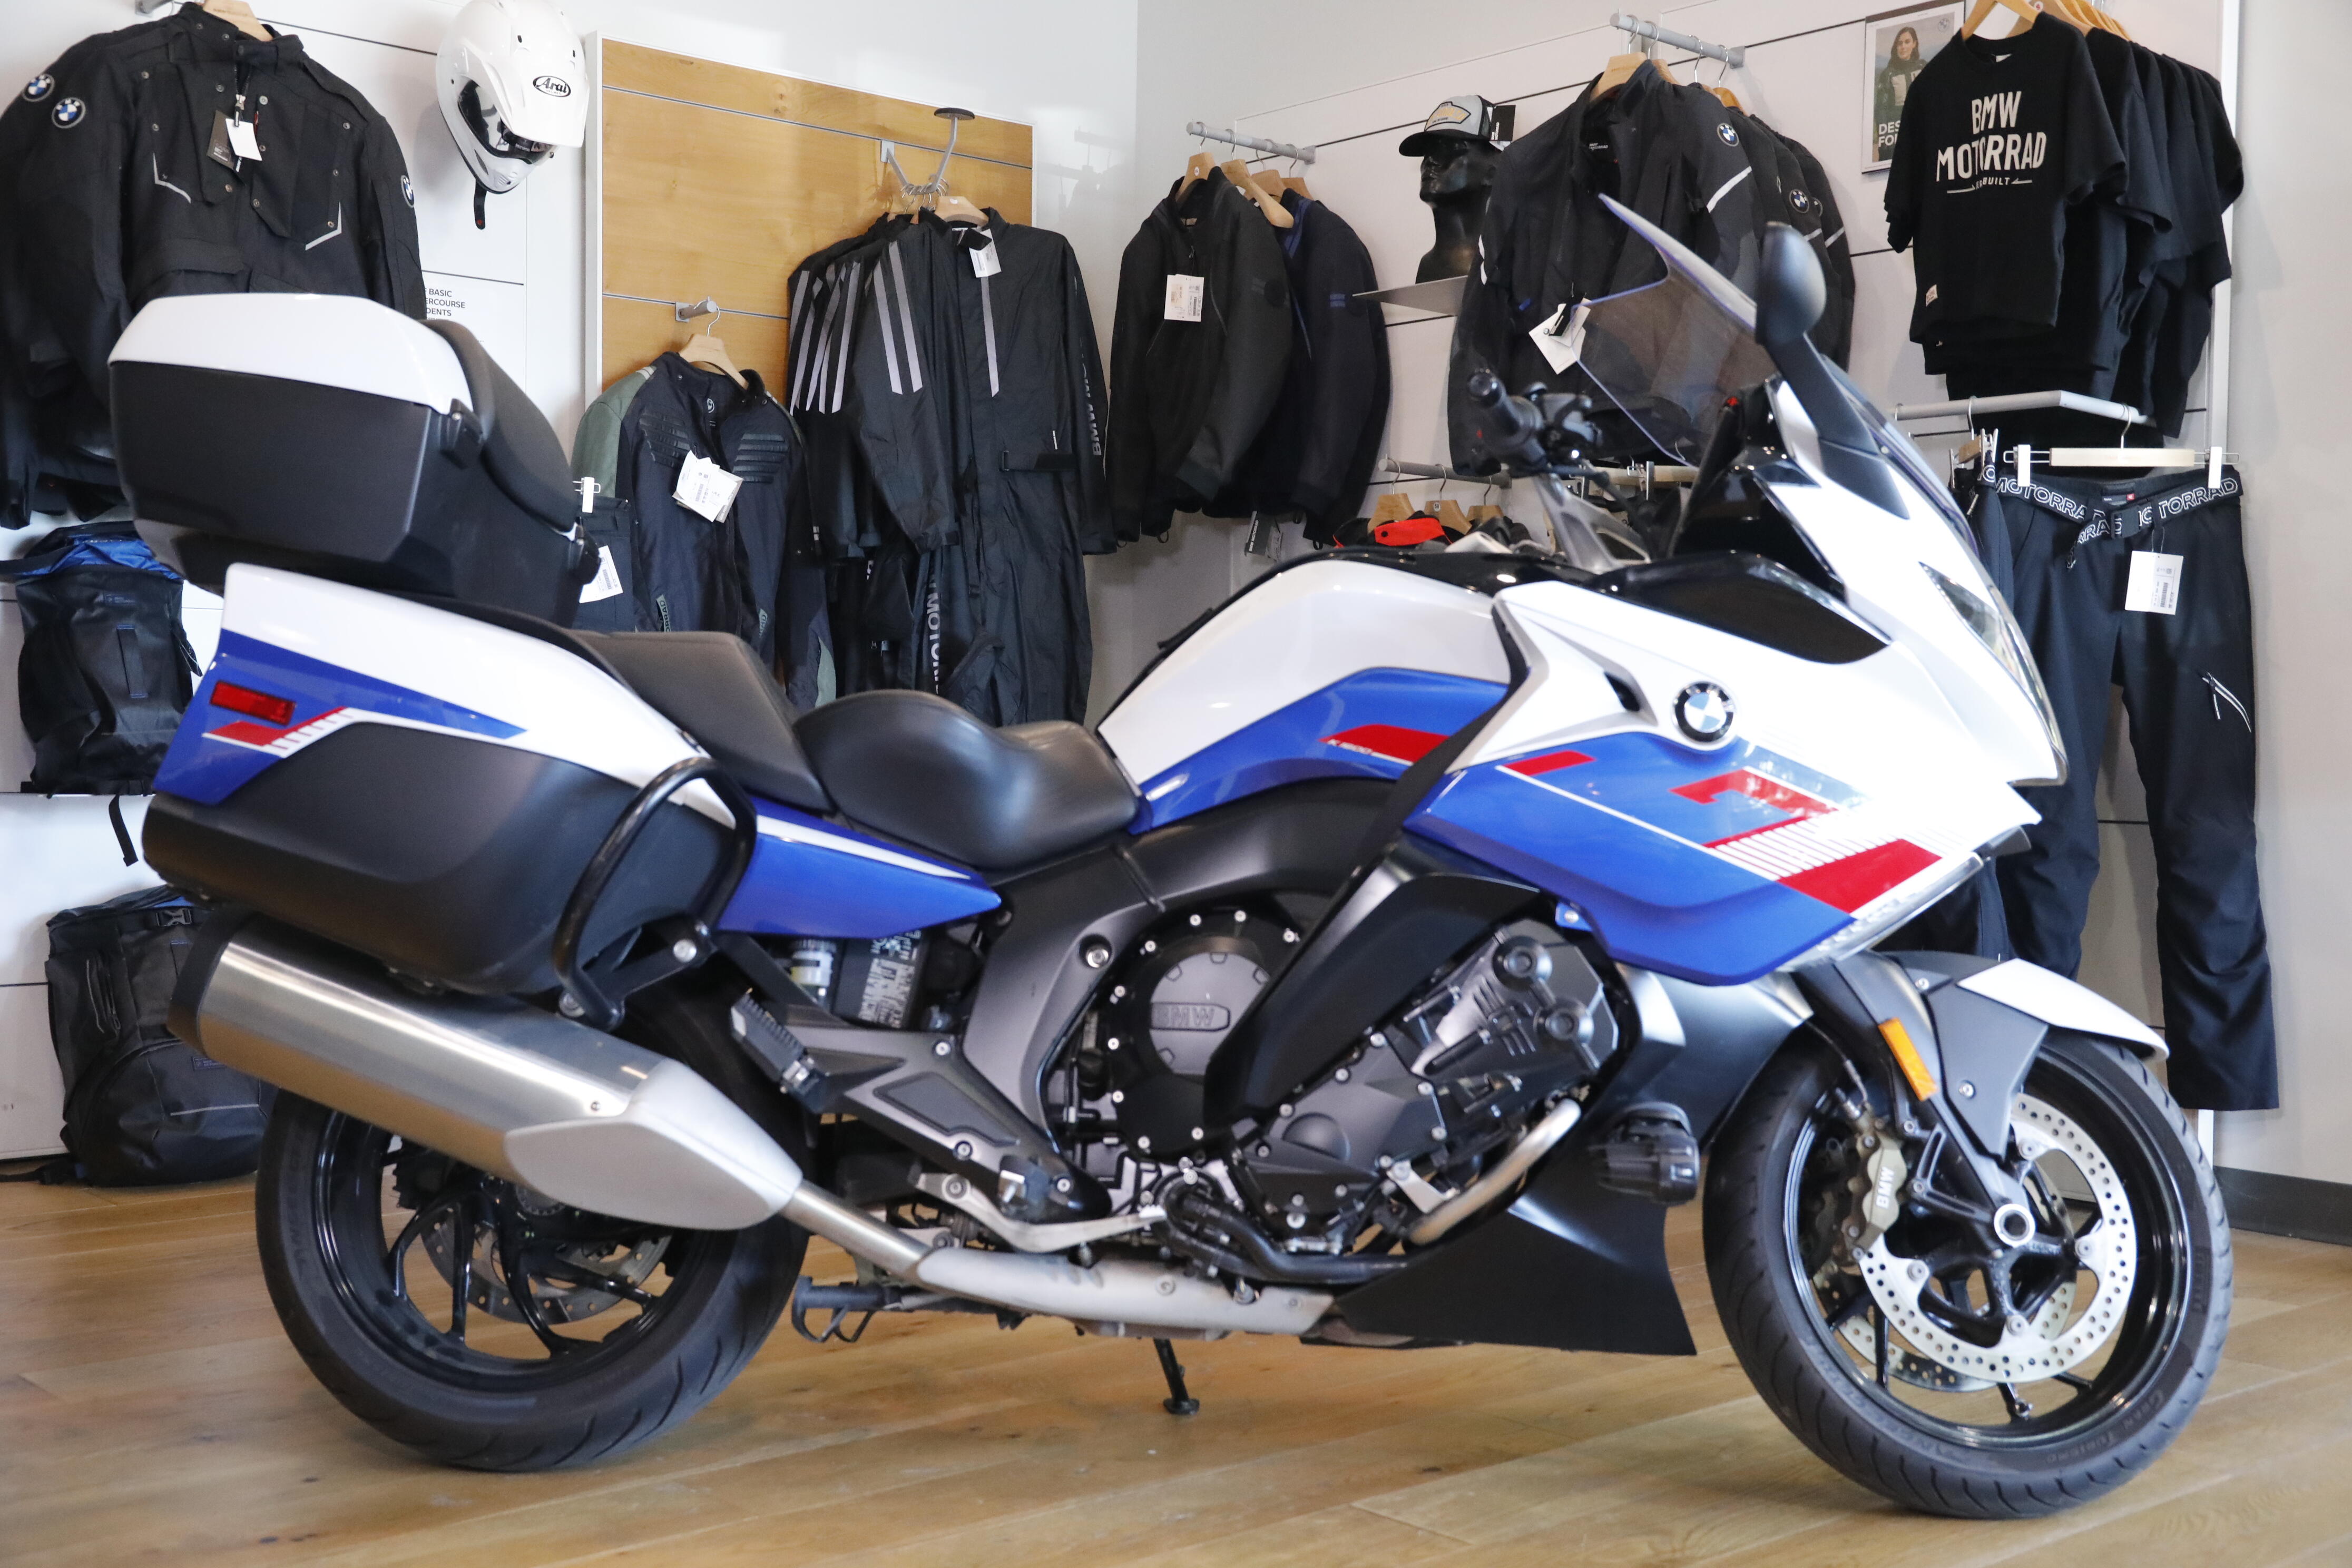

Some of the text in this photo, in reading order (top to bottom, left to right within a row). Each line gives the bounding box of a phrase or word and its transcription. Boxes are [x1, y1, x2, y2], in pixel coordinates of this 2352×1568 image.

[536, 77, 567, 93] Arai
[1972, 91, 2022, 135] BMW
[1936, 131, 2047, 182] MOTORRAD
[1982, 177, 2011, 185] BUILT
[429, 288, 453, 297] BASIC
[426, 307, 452, 316] DENTS
[1154, 1005, 1216, 1026] BMW
[1876, 1166, 1895, 1209] BMW
